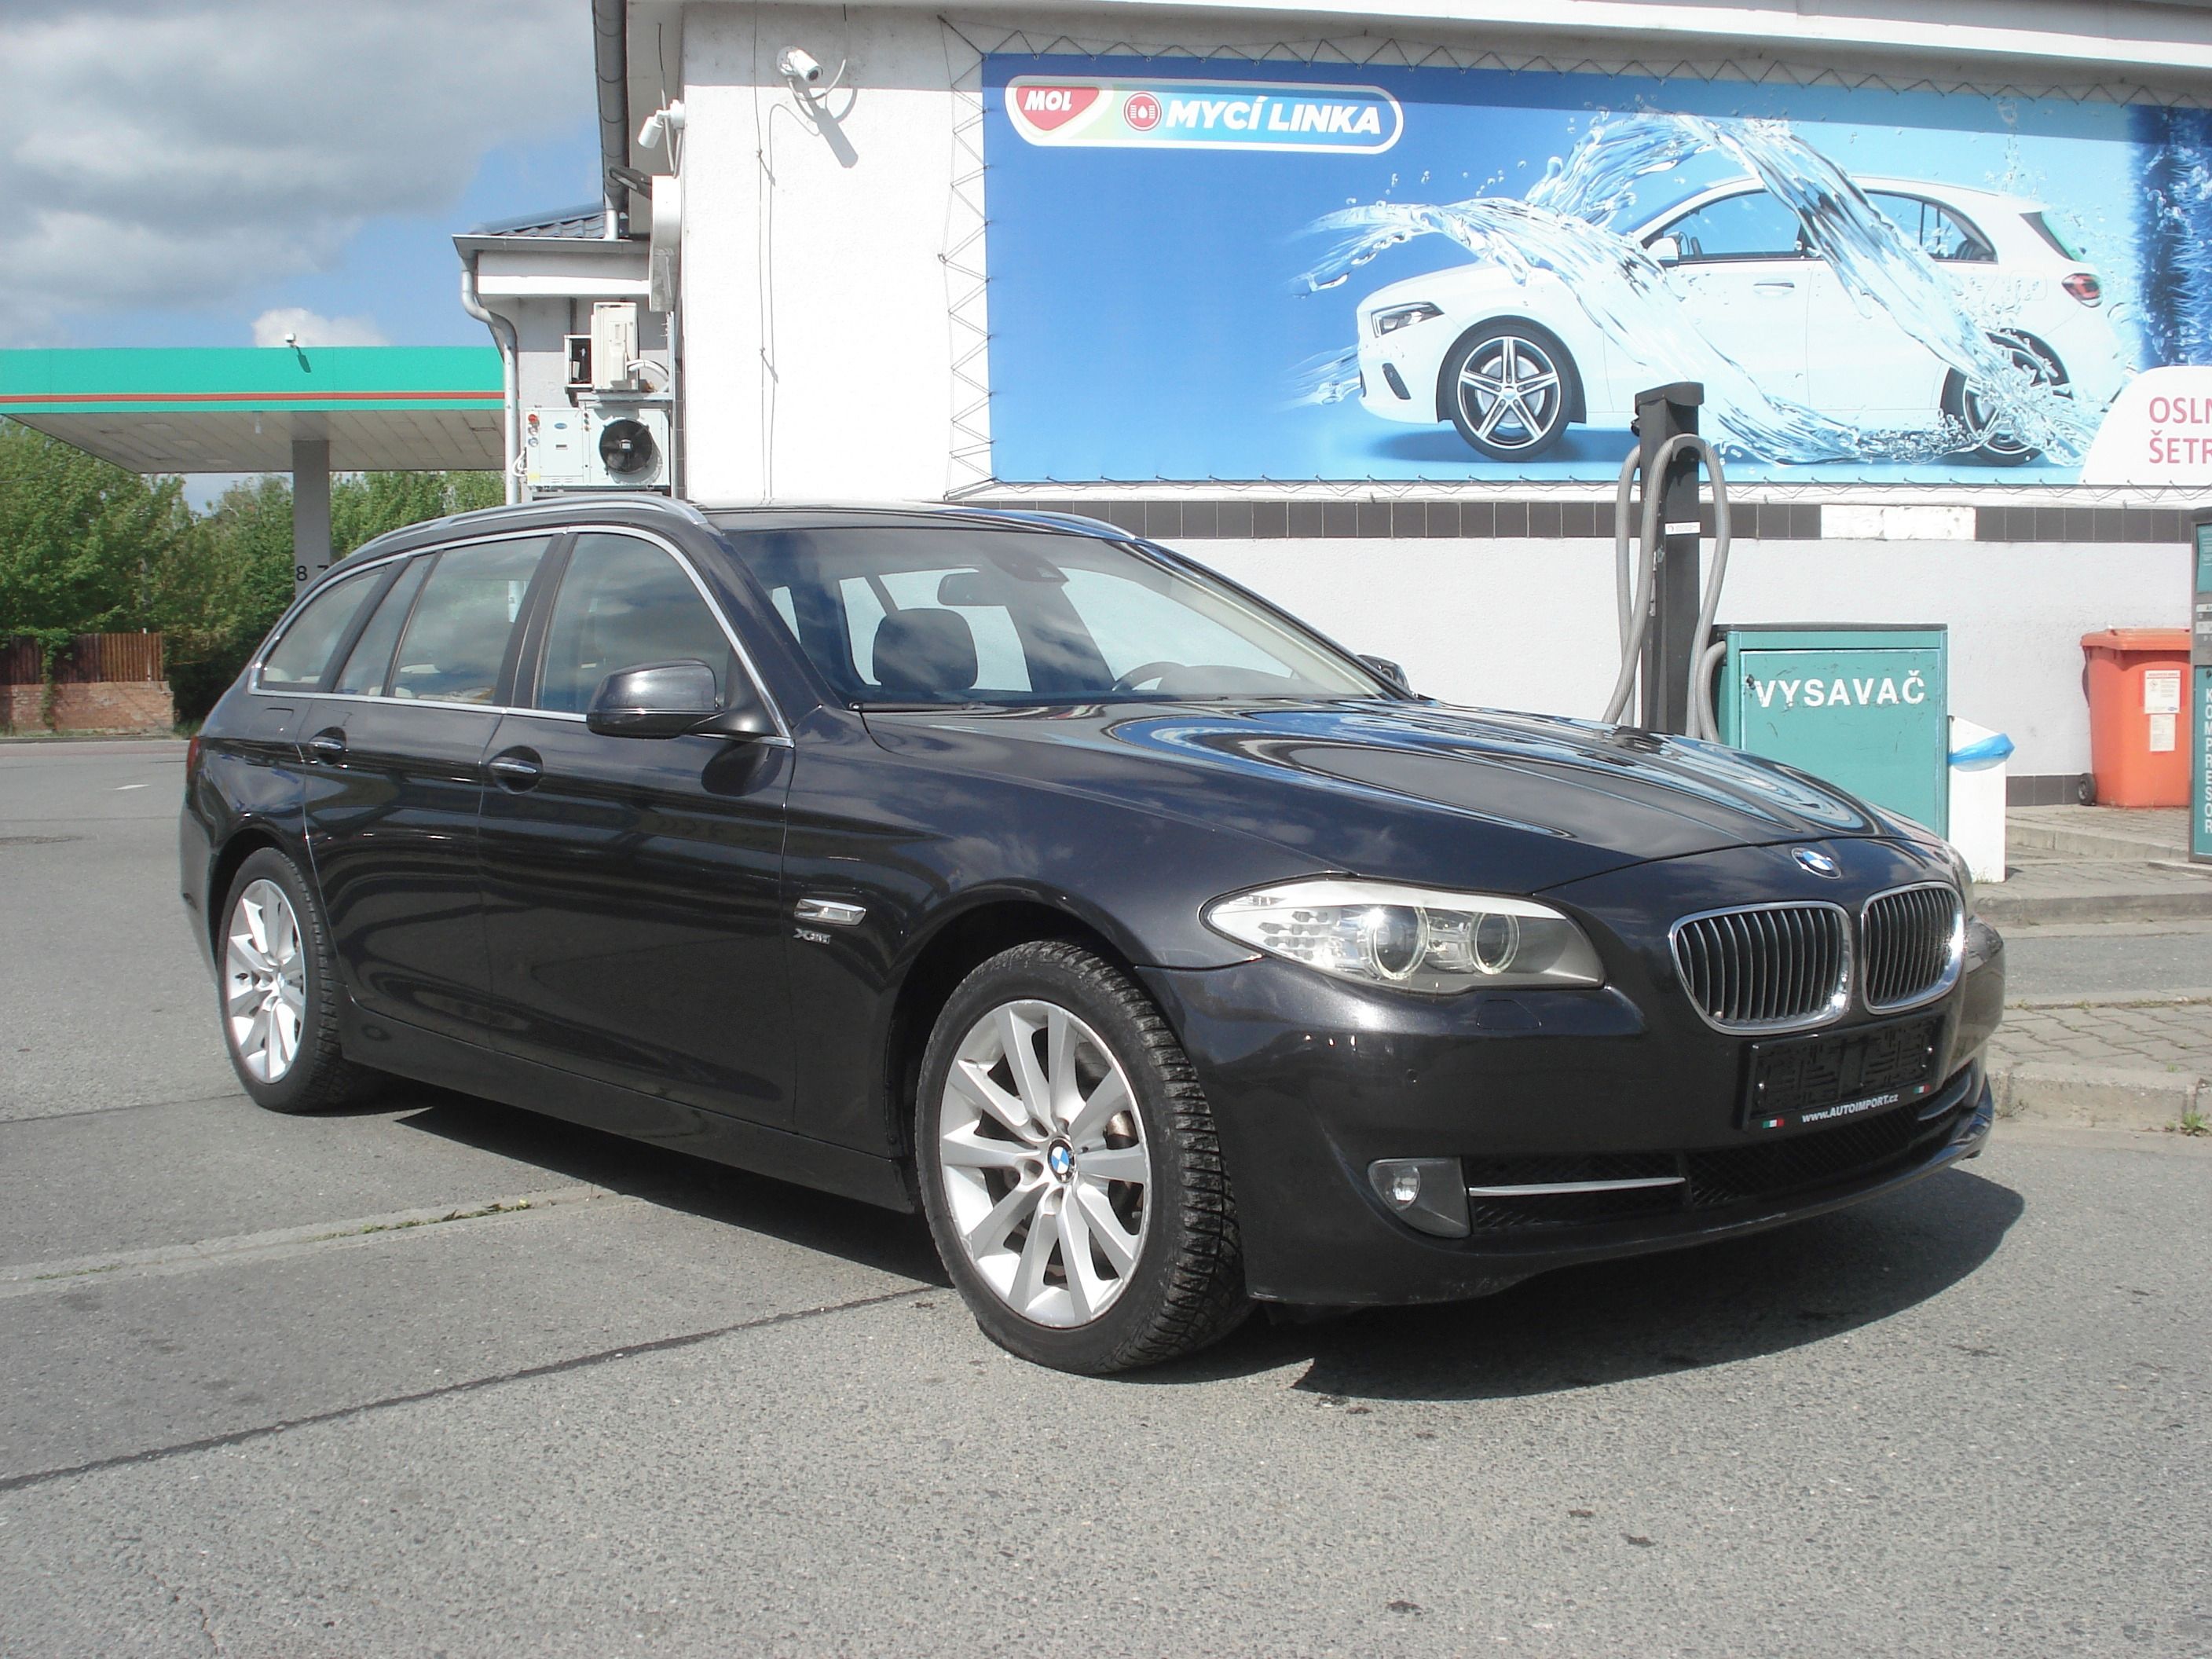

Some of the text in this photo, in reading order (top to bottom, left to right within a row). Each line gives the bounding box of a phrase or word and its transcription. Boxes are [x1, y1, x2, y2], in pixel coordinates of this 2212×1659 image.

[1024, 90, 1073, 112] MOL
[1165, 95, 1381, 134] MYCÍ LINKA
[296, 566, 308, 580] 8
[1755, 670, 1925, 708] VYSAVAČ
[1801, 1093, 1899, 1122] www.AUTOIMPORT.cz
